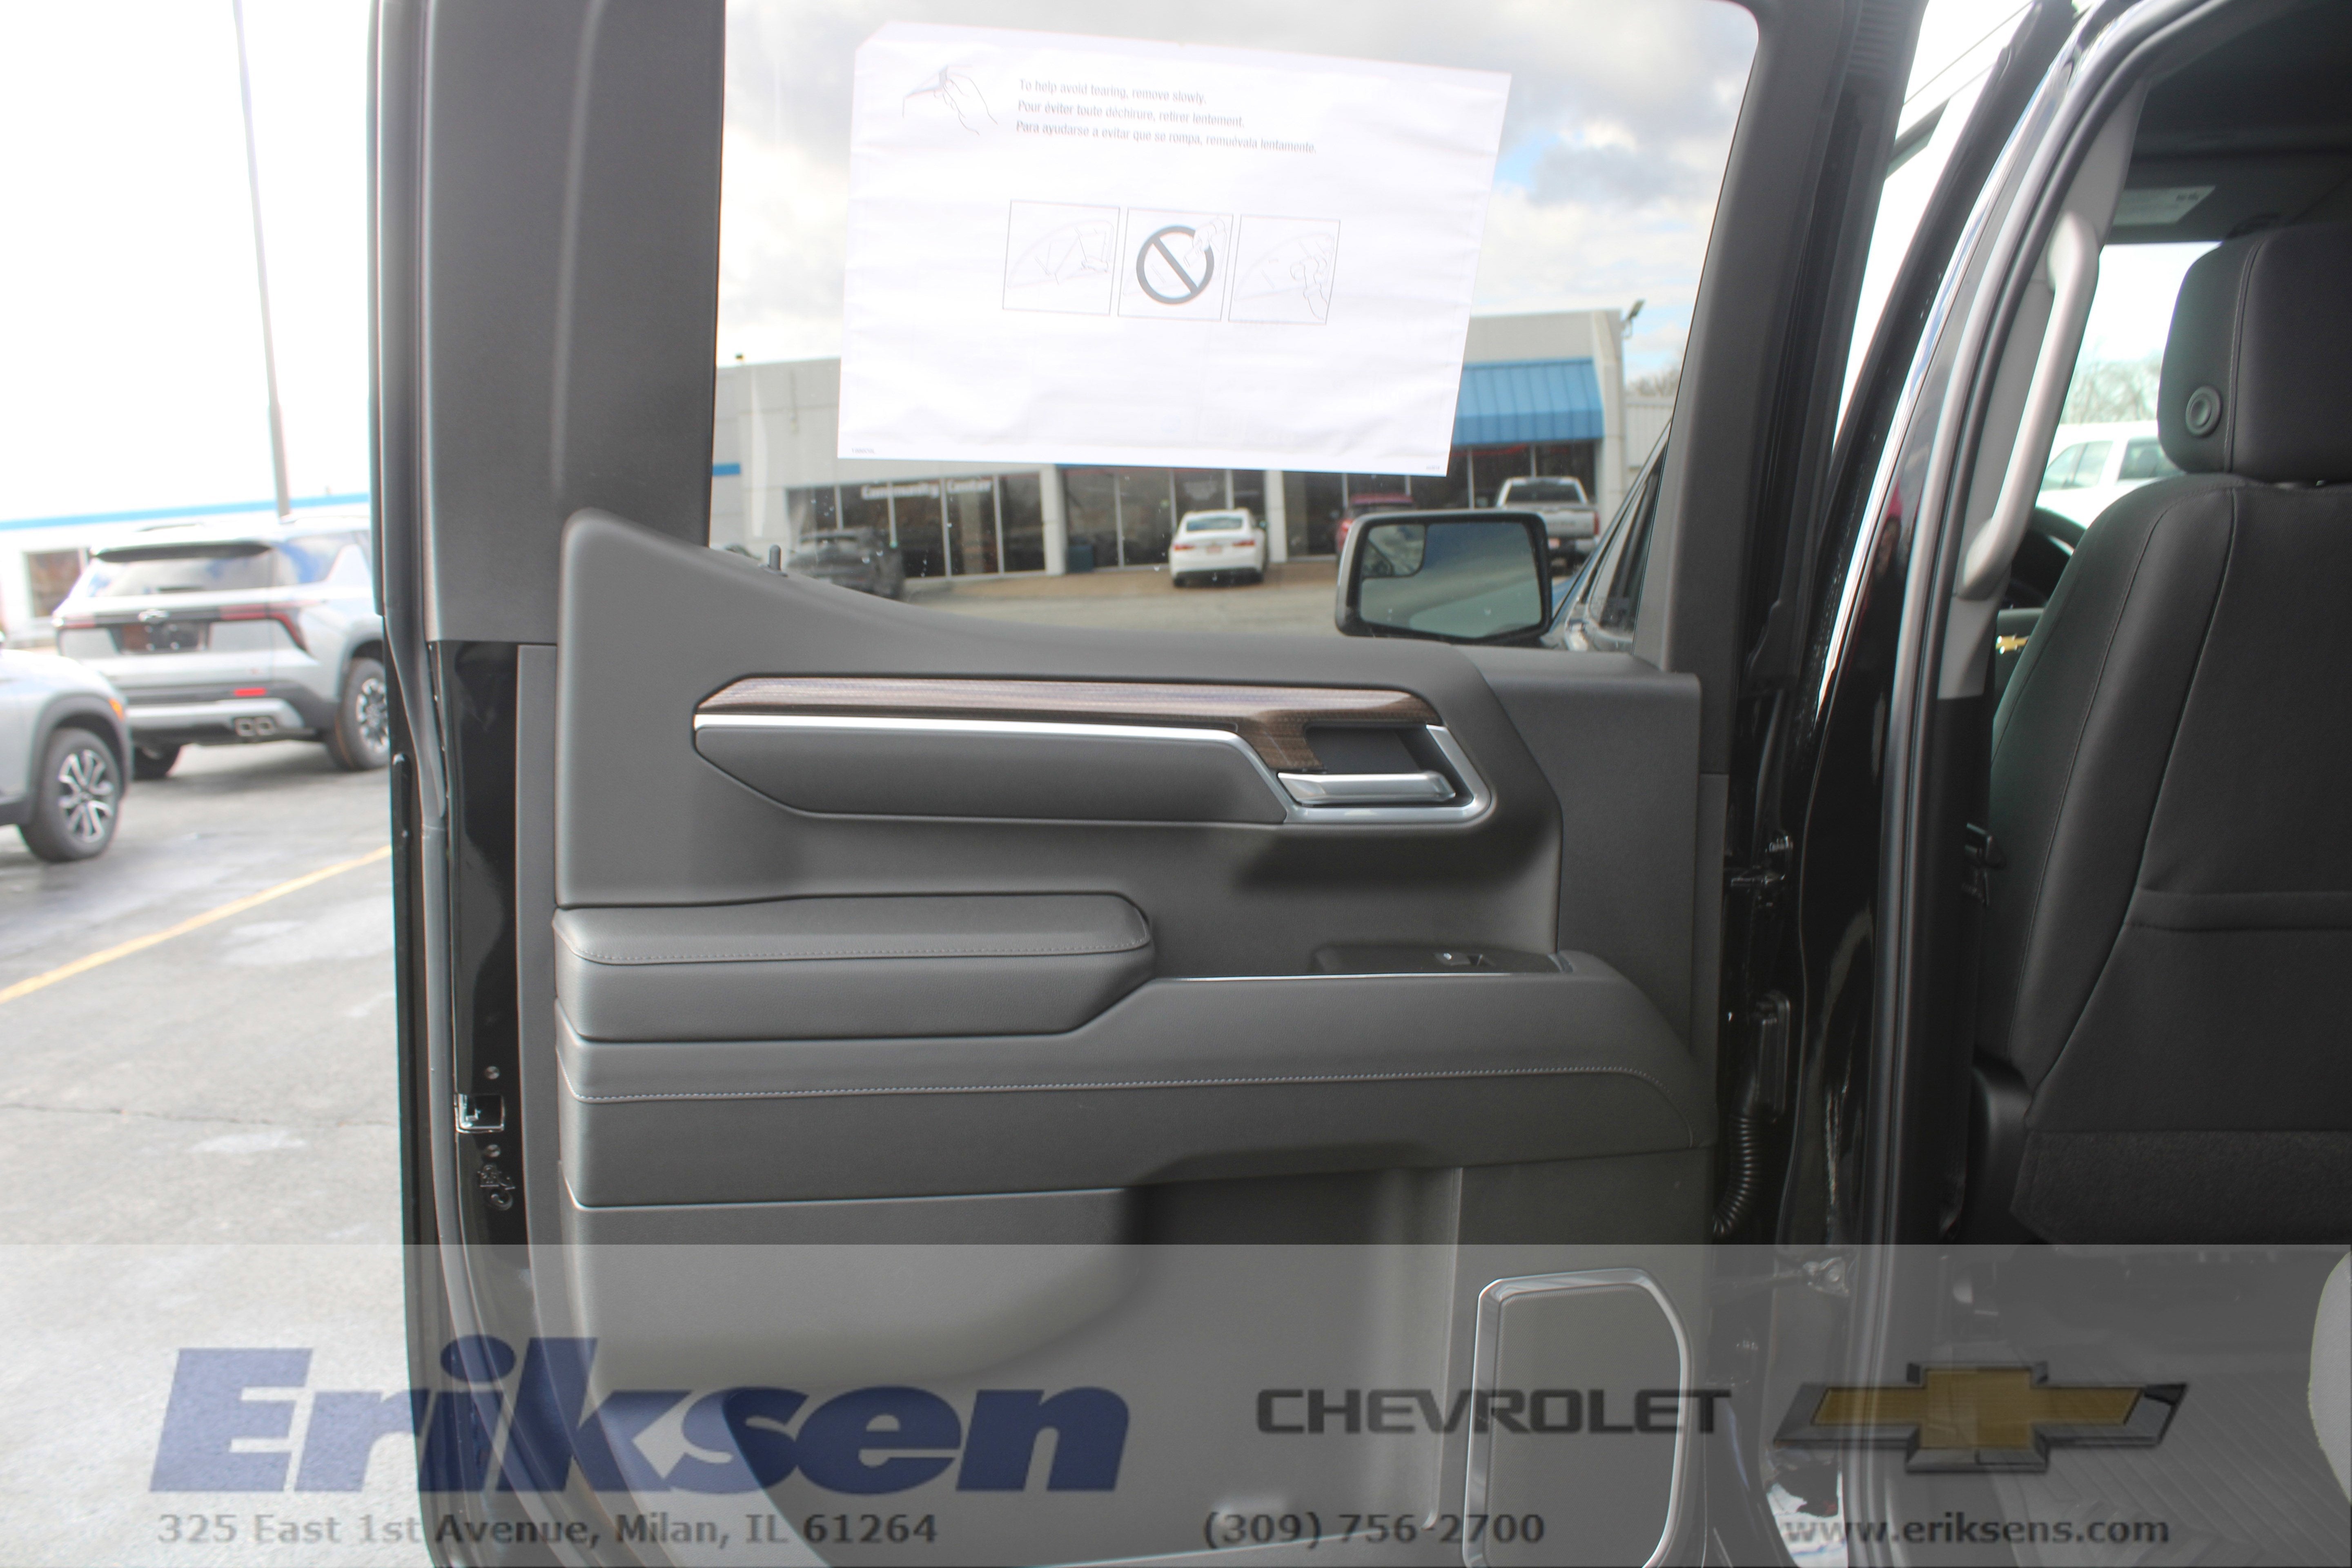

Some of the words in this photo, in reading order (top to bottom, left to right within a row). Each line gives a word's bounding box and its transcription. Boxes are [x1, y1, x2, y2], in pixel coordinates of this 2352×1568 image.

[1019, 78, 1032, 91] To
[1035, 80, 1057, 95] help
[1060, 82, 1088, 95] avoid
[1090, 84, 1129, 100] tearing,
[1132, 89, 1169, 101] remove
[1172, 90, 1207, 107] slowly.
[1018, 99, 1042, 113] Pour
[1044, 101, 1074, 116] éviter
[1077, 104, 1102, 118] toute
[1105, 105, 1156, 122] déchirure,
[1159, 110, 1190, 124] retirer
[1192, 111, 1245, 129] lentement.
[1016, 119, 1040, 134] Para
[1042, 122, 1090, 137] ayudarse
[1092, 128, 1099, 138] a
[1102, 127, 1131, 140] evitar
[1133, 130, 1152, 143] que
[1154, 131, 1166, 142] se
[1169, 132, 1203, 147] rompa,
[1206, 134, 1258, 149] remuévala
[1261, 137, 1317, 155] lentamente.
